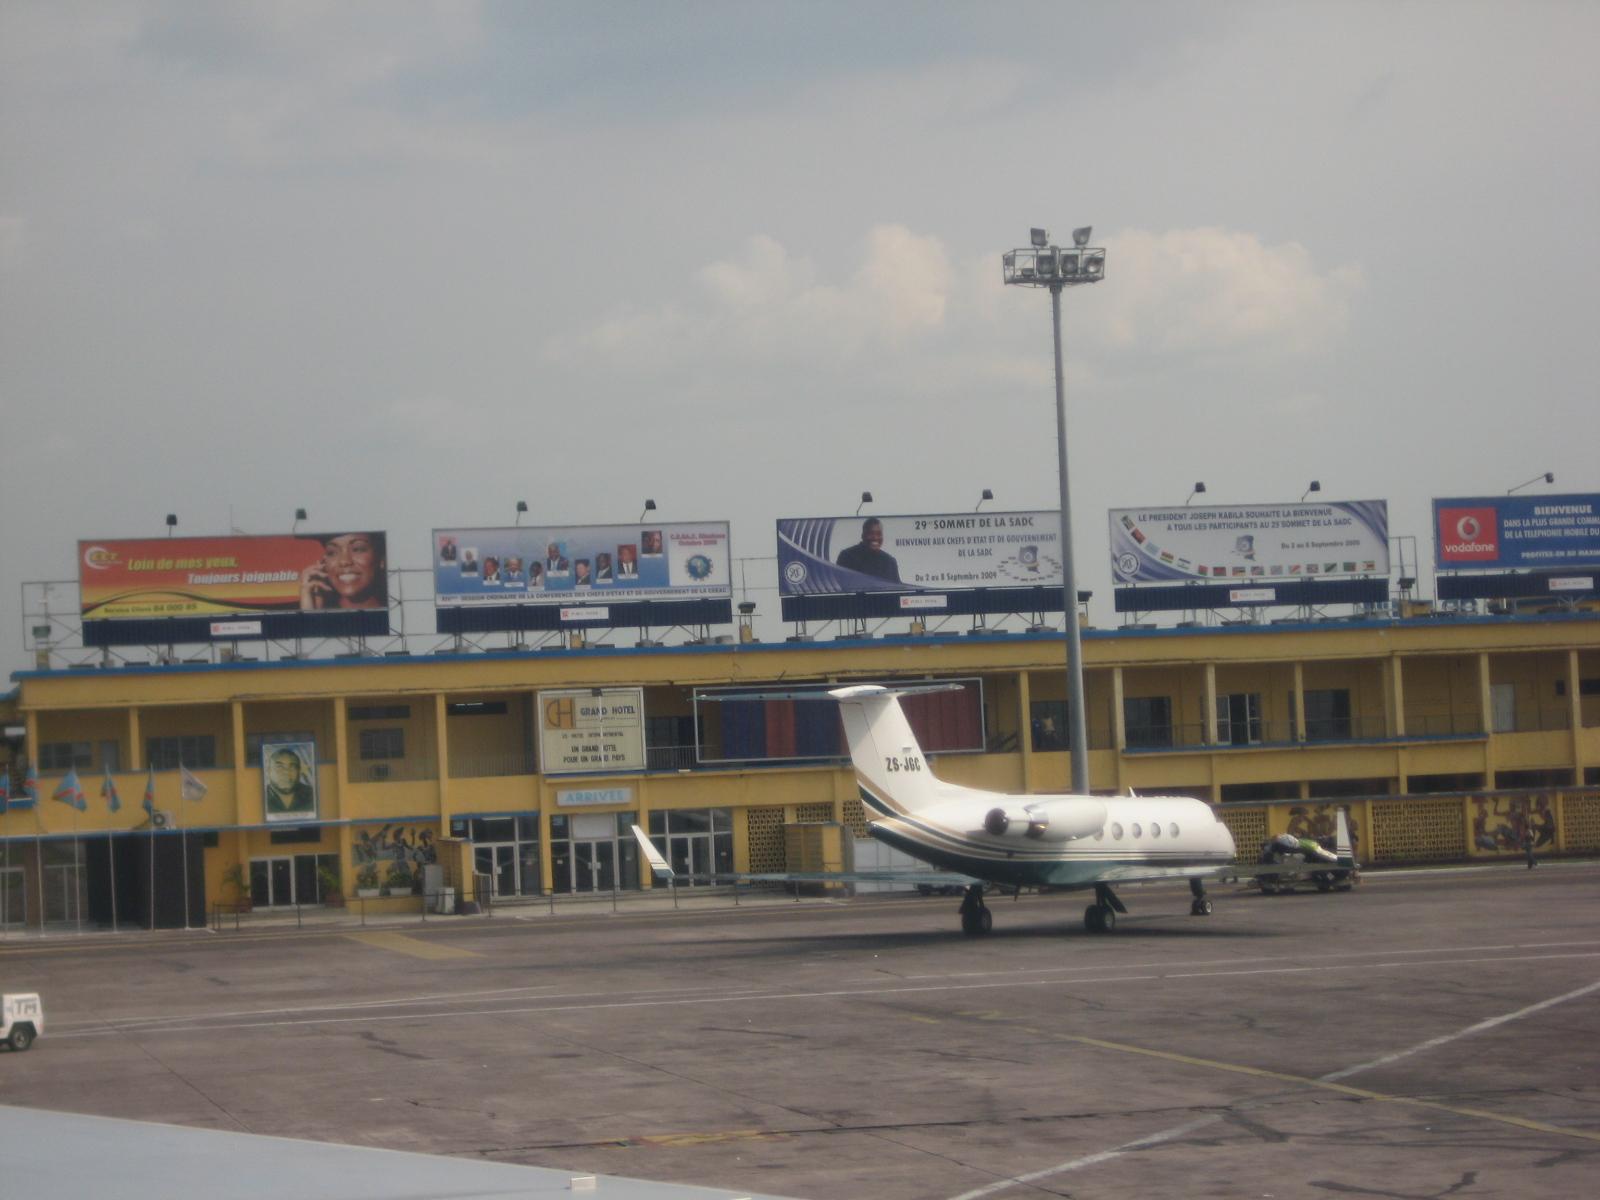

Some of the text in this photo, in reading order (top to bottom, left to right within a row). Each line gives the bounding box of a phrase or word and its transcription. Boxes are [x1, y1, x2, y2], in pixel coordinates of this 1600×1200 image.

[1149, 513, 1187, 521] PRESIDENT
[1190, 512, 1216, 520] JOSEPH
[1246, 510, 1280, 518] SOUHAITE
[1293, 508, 1333, 516] BIENVENUE
[1534, 505, 1592, 515] BIENVENUE
[934, 518, 975, 529] SOMMET
[980, 518, 991, 528] DE
[995, 518, 1006, 527] LA
[1009, 517, 1034, 527] SADC
[1504, 519, 1522, 527] DANS
[1522, 519, 1530, 527] LA
[1531, 518, 1547, 526] PLUS
[896, 537, 930, 546] BIENVENUE
[933, 536, 945, 545] AUX
[948, 536, 965, 545] CHEFS
[989, 535, 995, 543] ET
[998, 534, 1005, 543] DE
[1007, 533, 1056, 543] GOUVERNEMENT
[1505, 530, 1513, 539] DE
[1515, 530, 1523, 538] LA
[977, 548, 992, 556] SADC
[1444, 542, 1495, 553] vodafone
[128, 558, 154, 571] Loin
[156, 558, 174, 570] de
[188, 571, 298, 584] Toujours joignable
[946, 572, 980, 582] Septembre
[580, 706, 635, 716] GRAND HOTEL
[885, 756, 920, 772] ZS-JGC
